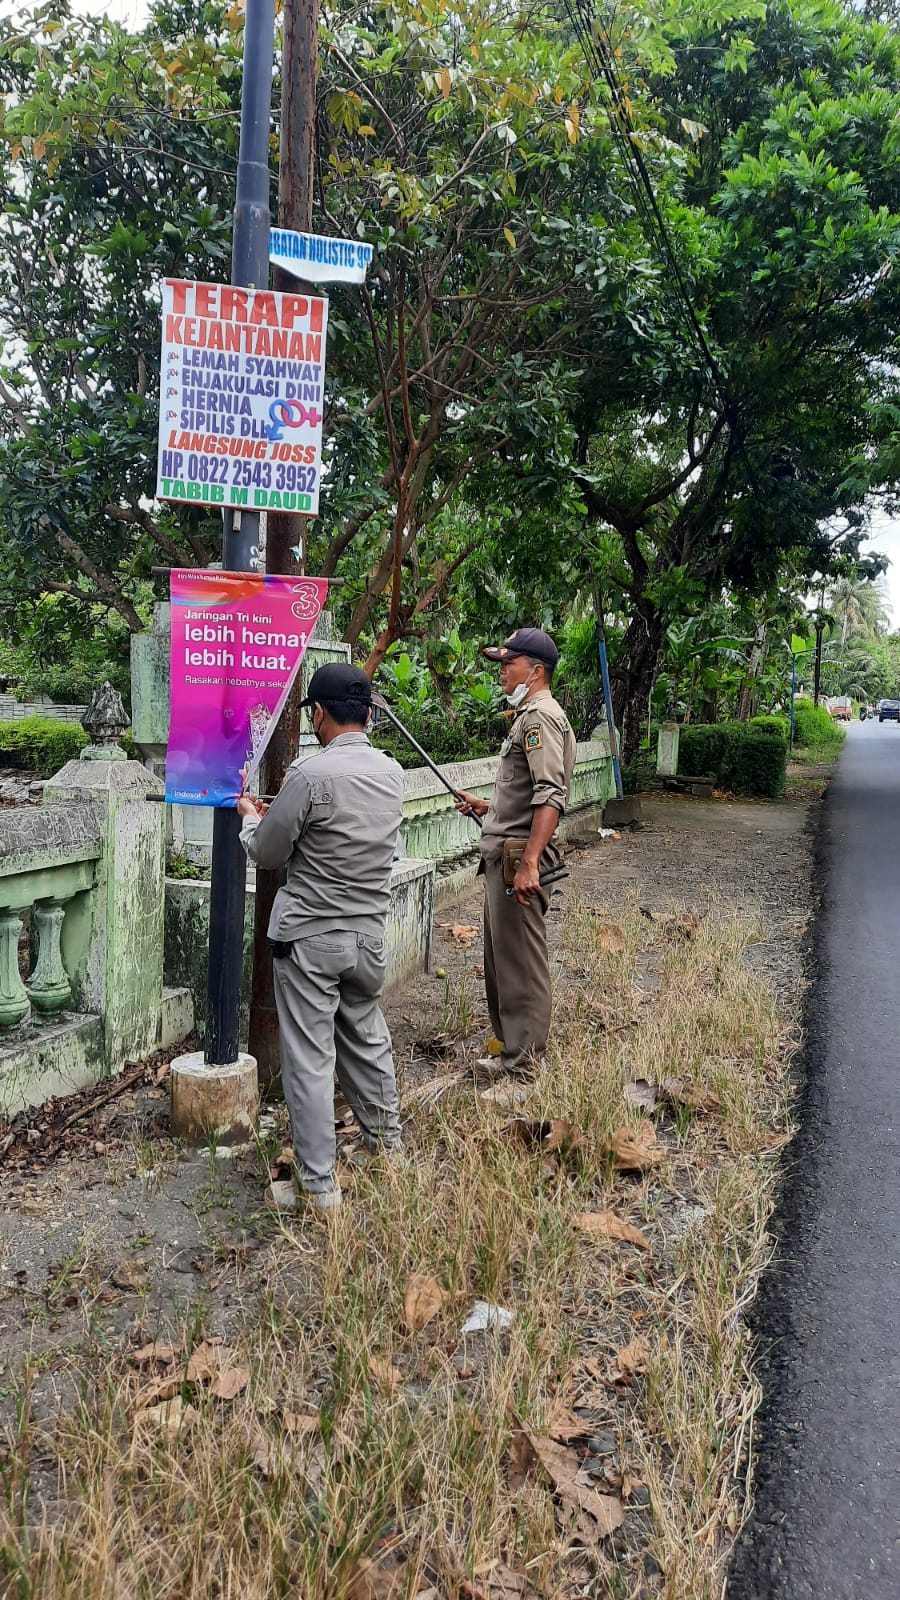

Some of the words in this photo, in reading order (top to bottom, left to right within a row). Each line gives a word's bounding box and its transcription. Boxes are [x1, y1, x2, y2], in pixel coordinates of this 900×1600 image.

[309, 236, 355, 268] HOLISTIC
[165, 279, 324, 332] TERAPI
[165, 315, 322, 362] KEJANTANAN
[182, 349, 239, 373] LEMAH
[245, 357, 321, 382] SYAHWAT
[182, 368, 280, 397] ENJAKULASI
[285, 381, 321, 401] DINI
[182, 388, 252, 416] HERNIA
[180, 409, 235, 435] SIPILIS
[240, 419, 268, 439] DLL
[168, 429, 267, 459] LANGSUNG
[269, 442, 316, 464] JOSS
[161, 450, 184, 478] HP.
[188, 453, 228, 484] 0822
[232, 459, 272, 489] 2543
[276, 463, 317, 493] 3952
[160, 477, 224, 502] TABIB
[230, 485, 248, 505] M
[254, 489, 312, 511] DAUD
[184, 609, 233, 624] Jaringan
[236, 611, 249, 622] Tri
[252, 613, 272, 624] kini
[185, 623, 235, 643] lebih
[241, 626, 308, 648] hemat
[185, 648, 234, 667] lebih
[241, 651, 292, 671] kuat.
[185, 675, 223, 685] Rasakan
[225, 676, 265, 688] hebatnya
